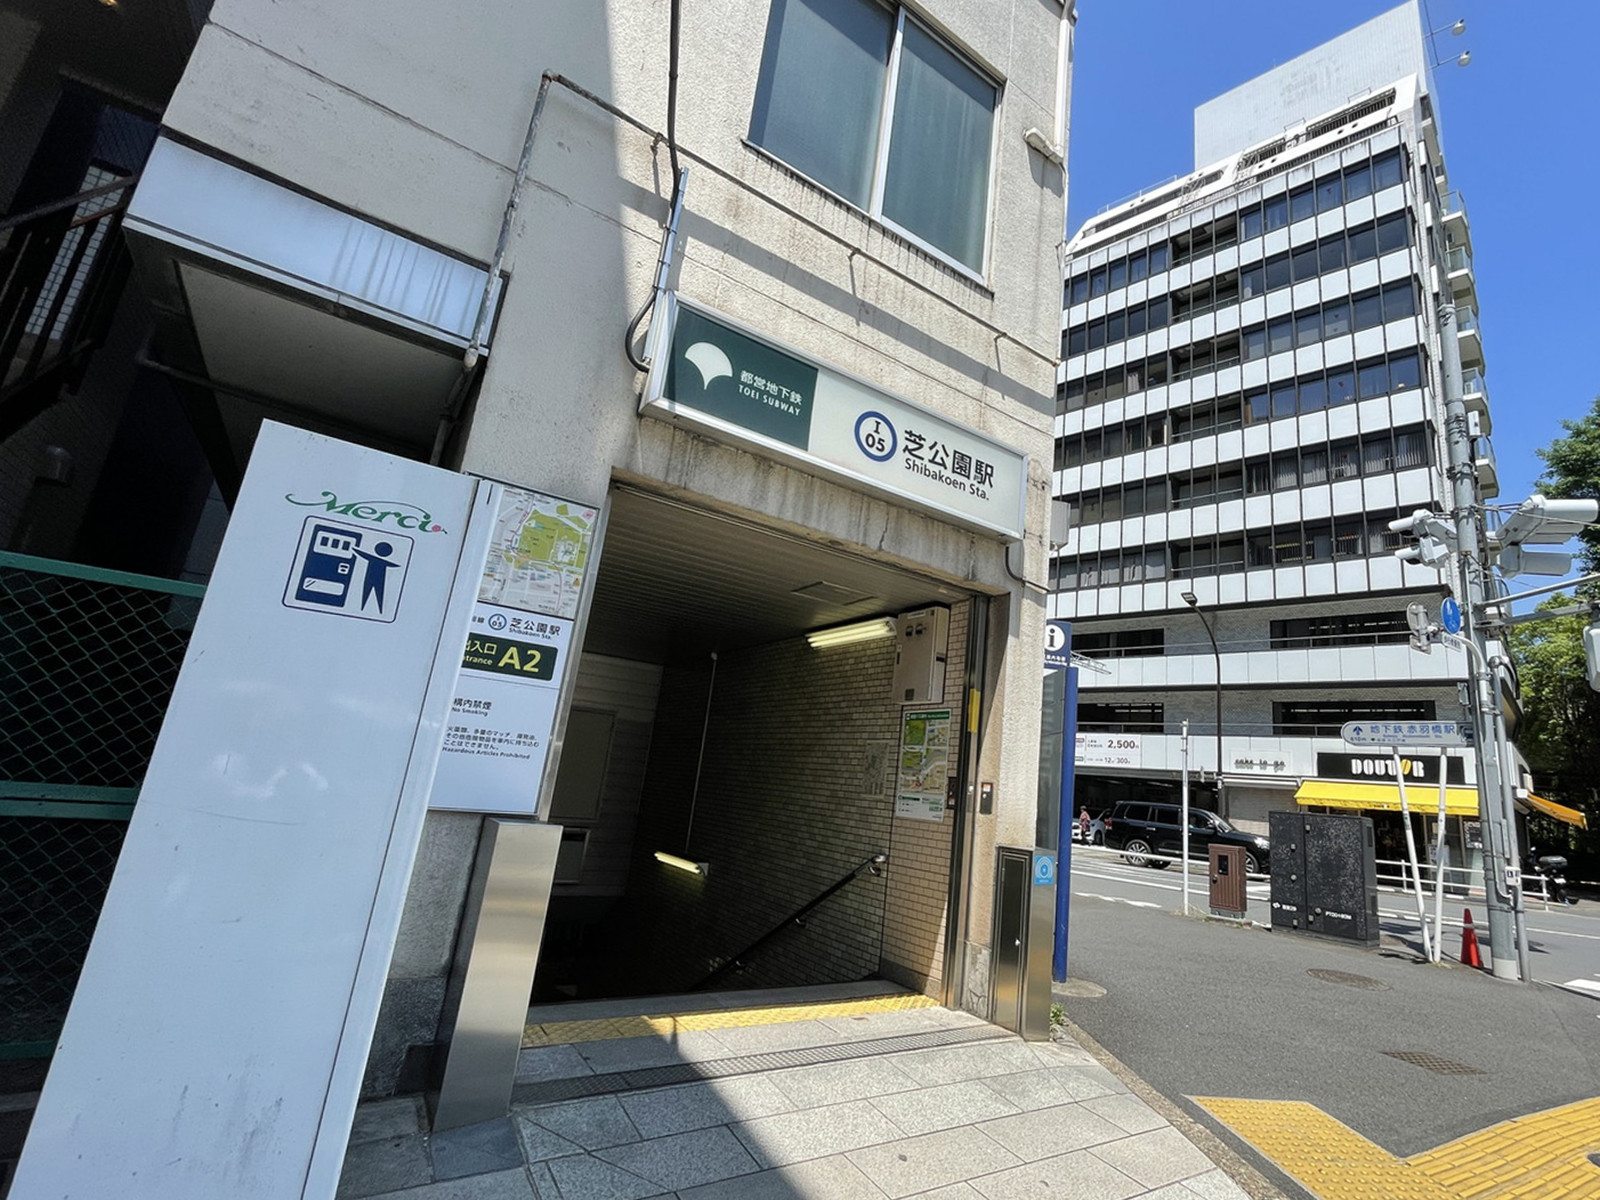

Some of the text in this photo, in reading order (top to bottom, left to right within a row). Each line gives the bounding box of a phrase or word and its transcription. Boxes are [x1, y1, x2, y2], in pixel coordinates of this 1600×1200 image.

[741, 370, 802, 405] 都営地下鉄
[739, 384, 801, 416] TOEI SUBWAY
[873, 420, 881, 434] I
[865, 433, 886, 453] 05
[902, 429, 994, 488] 芝公園駅
[905, 458, 990, 500] Shibakoen Sta.
[285, 491, 434, 533] Merci
[510, 617, 561, 636] 芝公園駅
[498, 646, 542, 673] A2
[453, 698, 492, 710] 構内禁煙
[462, 708, 488, 717] Smoking
[1351, 759, 1425, 777] DOUTOR
